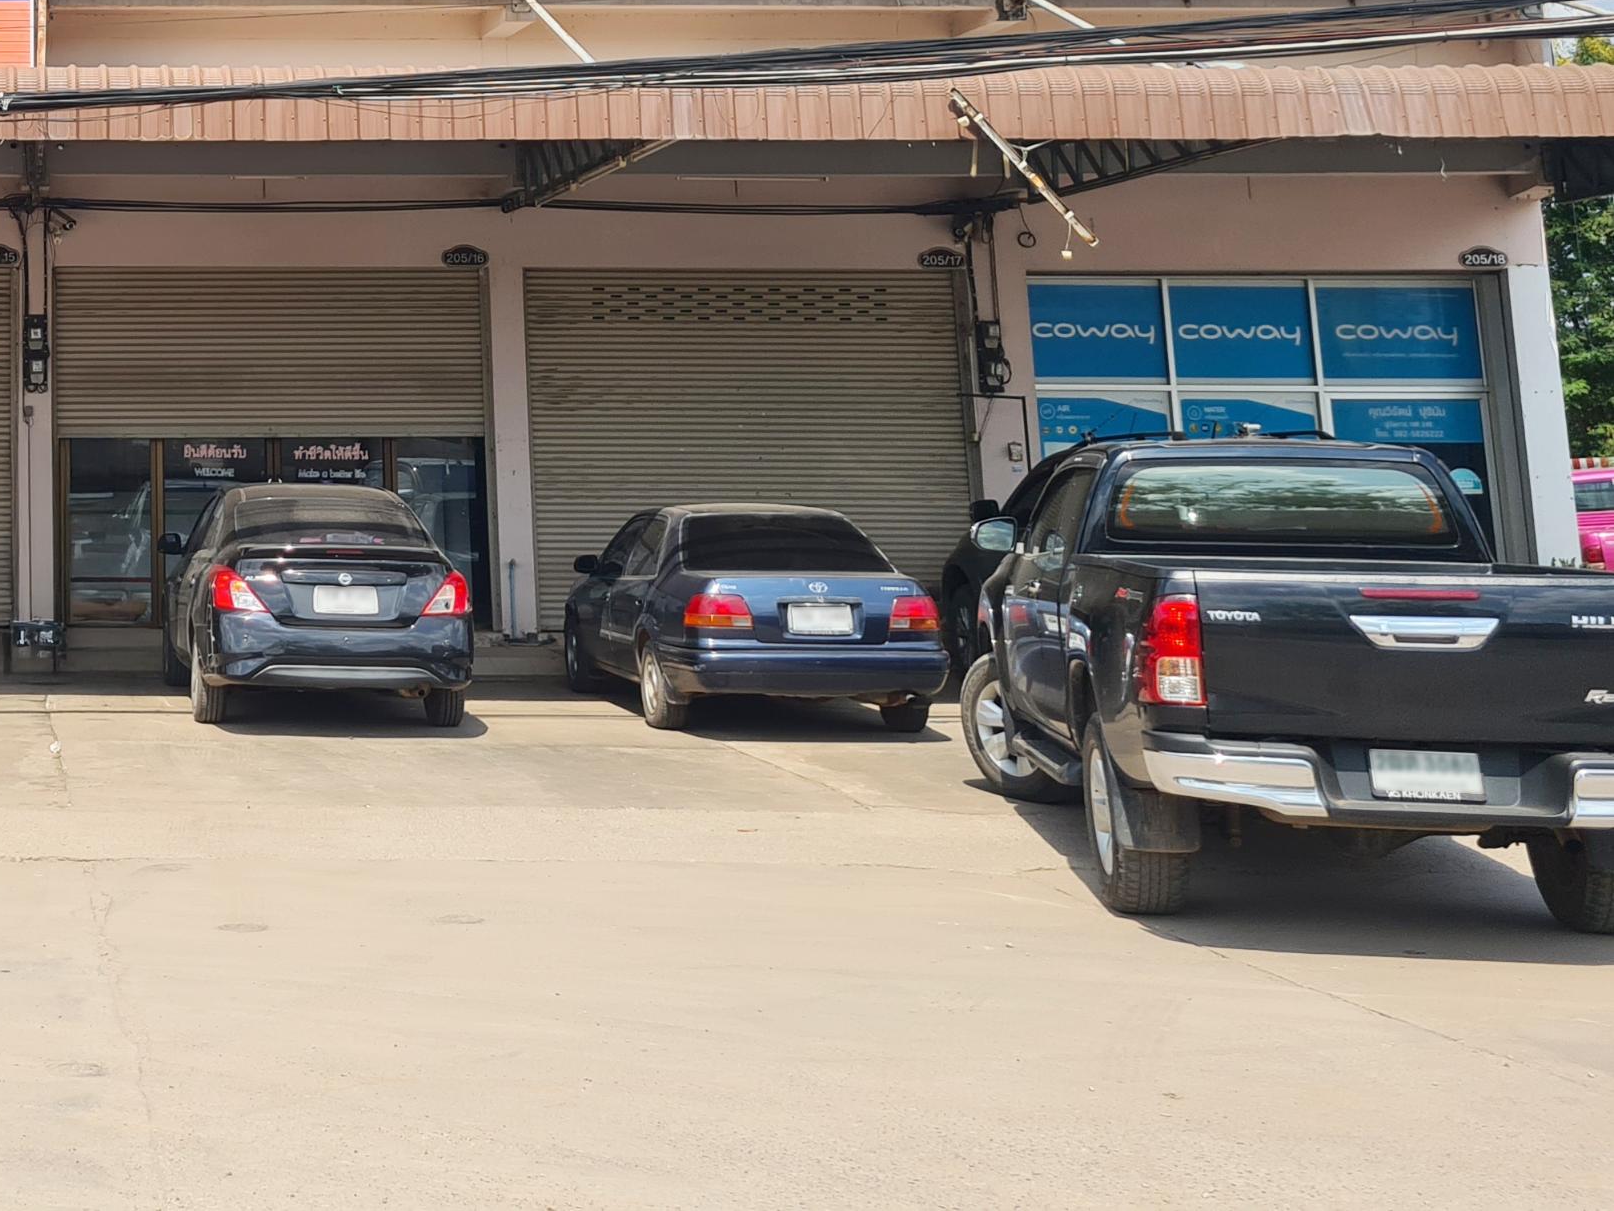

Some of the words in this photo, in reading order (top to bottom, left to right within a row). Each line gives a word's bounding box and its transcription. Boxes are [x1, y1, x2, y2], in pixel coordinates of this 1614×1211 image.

[446, 252, 485, 264] 205/16
[922, 254, 962, 266] 205/17
[1464, 253, 1506, 265] 205/18
[1206, 610, 1262, 622] TOYOTA
[1571, 615, 1614, 628] HIL
